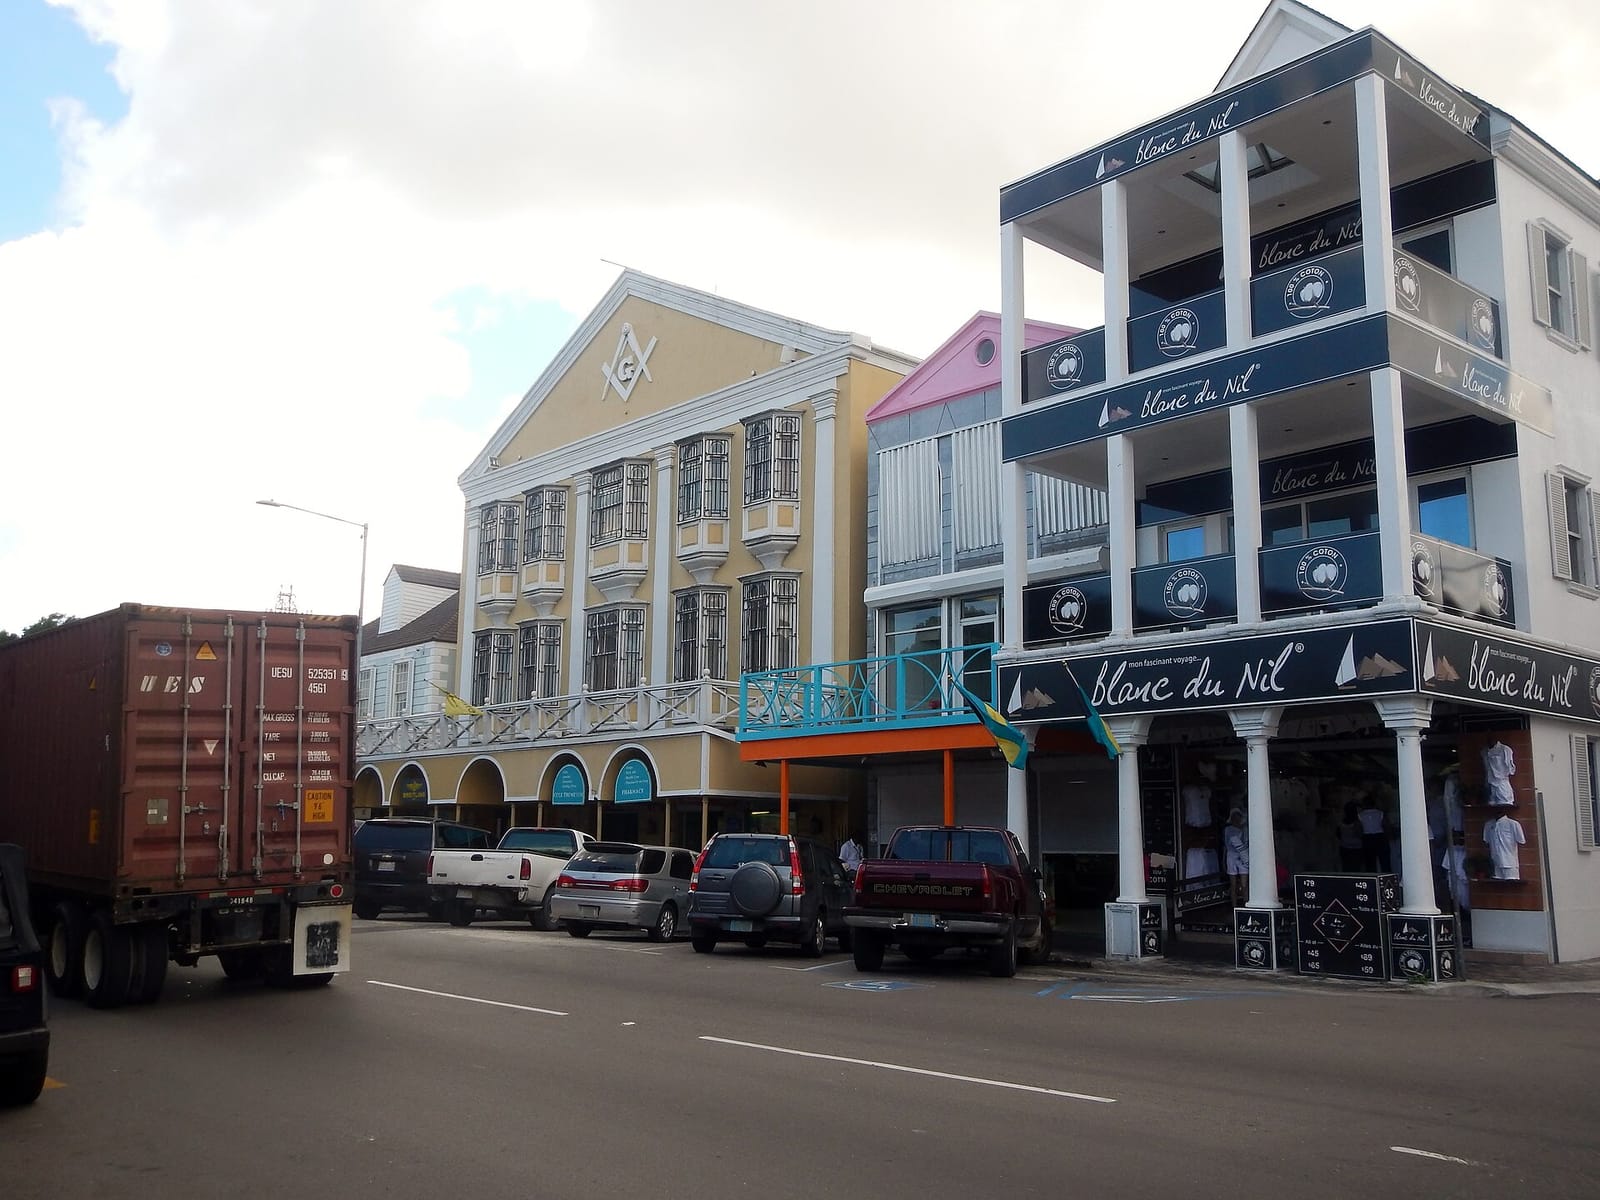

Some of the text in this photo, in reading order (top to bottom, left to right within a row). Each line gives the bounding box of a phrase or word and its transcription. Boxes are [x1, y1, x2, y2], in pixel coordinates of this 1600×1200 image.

[1448, 103, 1460, 125] du
[1181, 121, 1202, 145] du
[1309, 228, 1332, 253] du
[1300, 268, 1325, 278] COTON
[1170, 310, 1192, 320] COTON
[1194, 378, 1218, 405] du
[1493, 381, 1507, 406] du
[1324, 460, 1347, 484] du
[1312, 548, 1339, 560] COTON
[1177, 570, 1200, 581] COTON
[1061, 588, 1081, 599] COTON
[1128, 661, 1143, 669] mon
[1143, 658, 1172, 668] fascinant
[1183, 655, 1225, 699] du
[1235, 641, 1294, 699] Nil
[271, 666, 293, 679] UESU
[307, 668, 337, 680] 525351
[1523, 661, 1545, 702] du
[1549, 664, 1573, 708] Nil
[264, 732, 281, 742] TARE
[263, 752, 276, 761] NET
[873, 883, 974, 896] CHEVROLET
